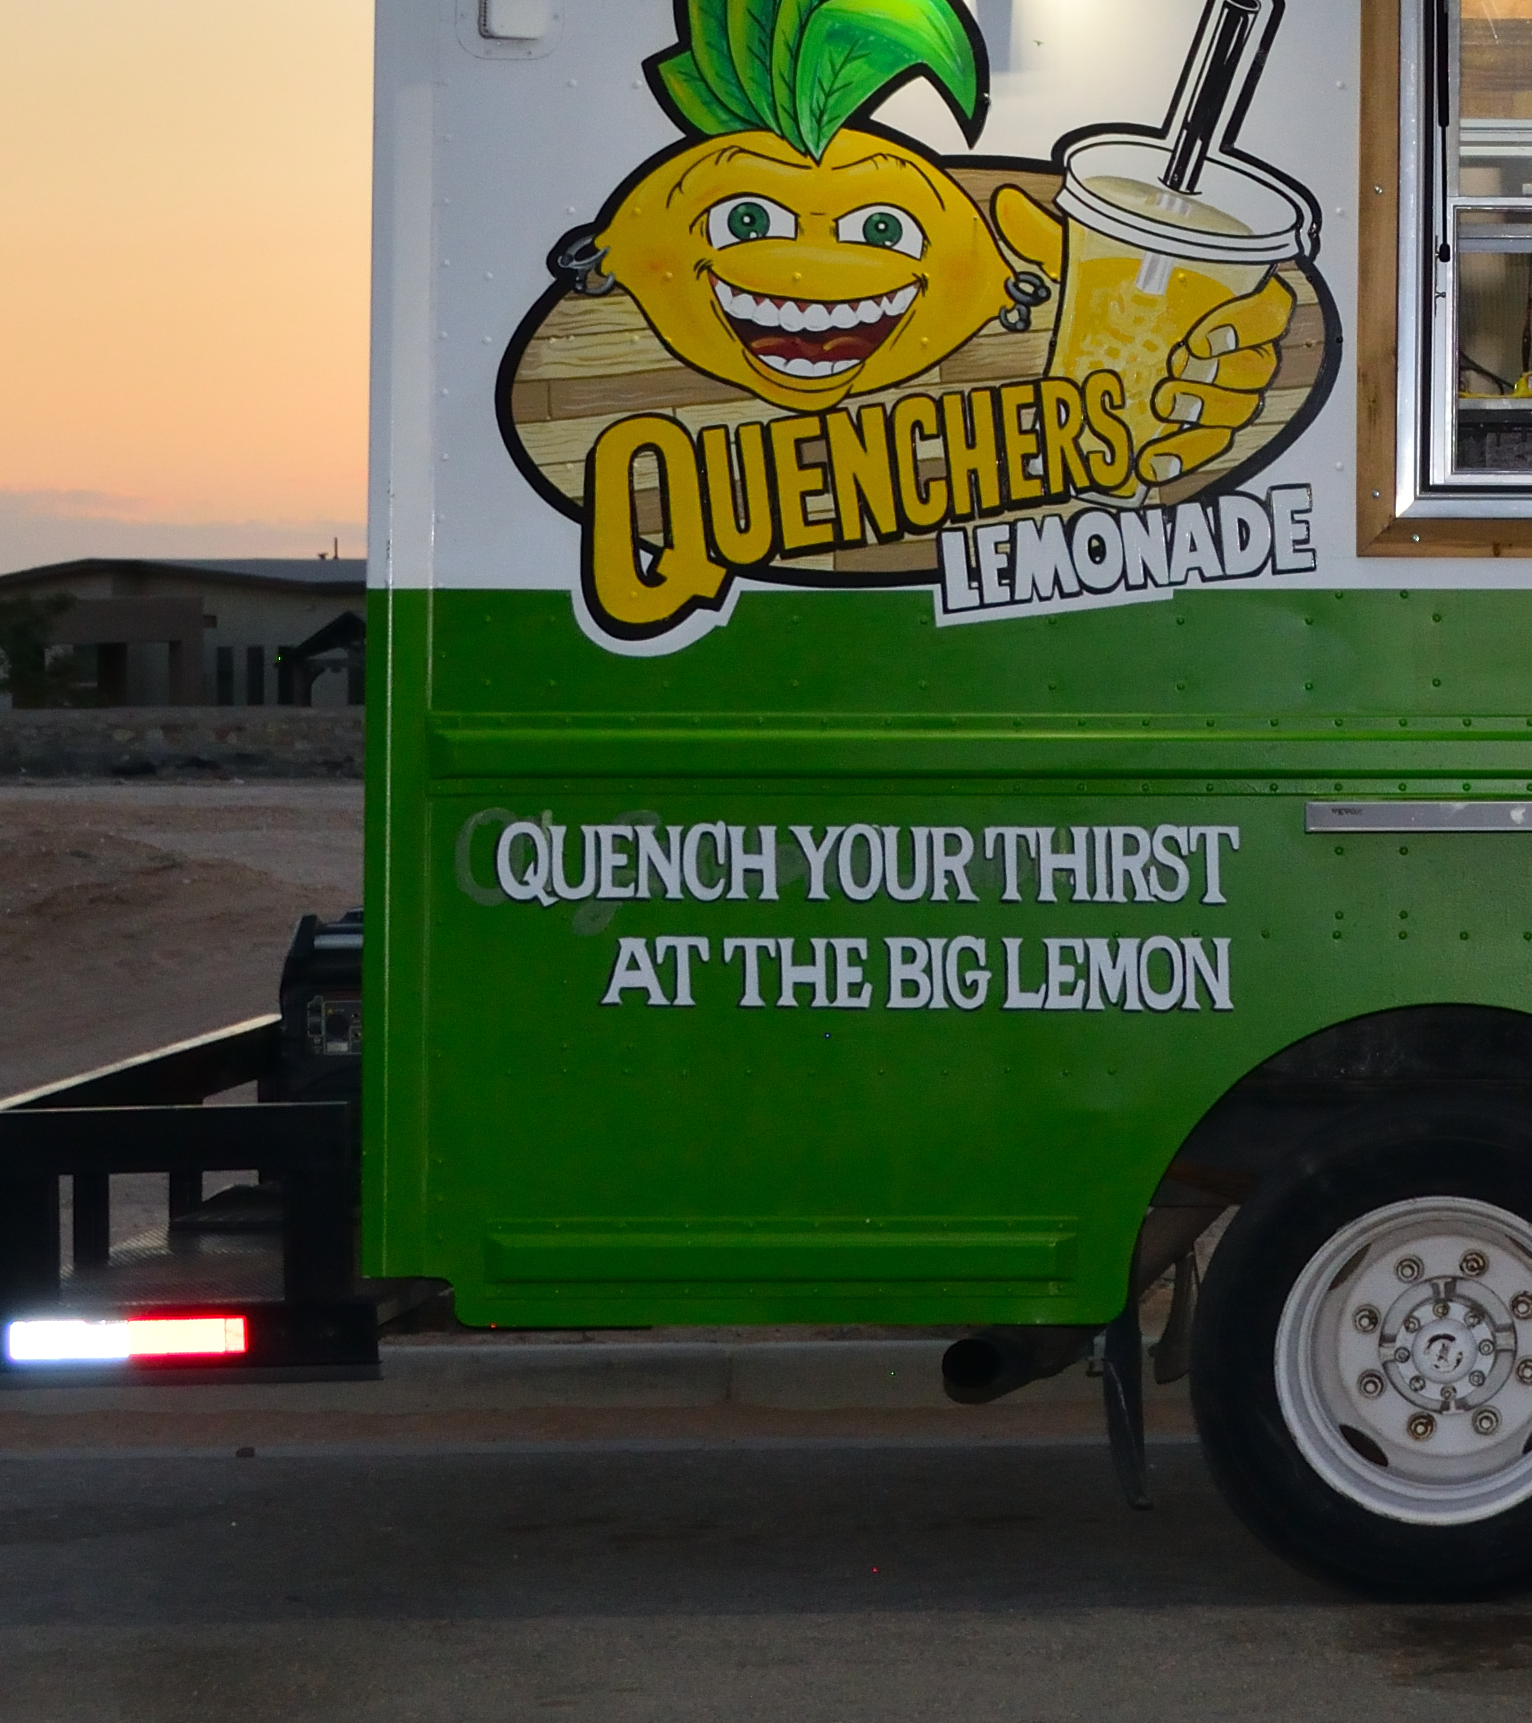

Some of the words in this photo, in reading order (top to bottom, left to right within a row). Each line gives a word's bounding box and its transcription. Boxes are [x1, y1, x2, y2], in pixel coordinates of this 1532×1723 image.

[588, 370, 1133, 636] QUENCHERS
[940, 483, 1320, 616] LEMONADE
[496, 820, 780, 907] QUENCH
[790, 822, 980, 904] YOUR
[985, 824, 1240, 905] THIRST
[600, 936, 710, 1008] AT
[723, 936, 872, 1009] THE
[886, 935, 992, 1011] BIG
[1003, 934, 1235, 1011] LEMON
